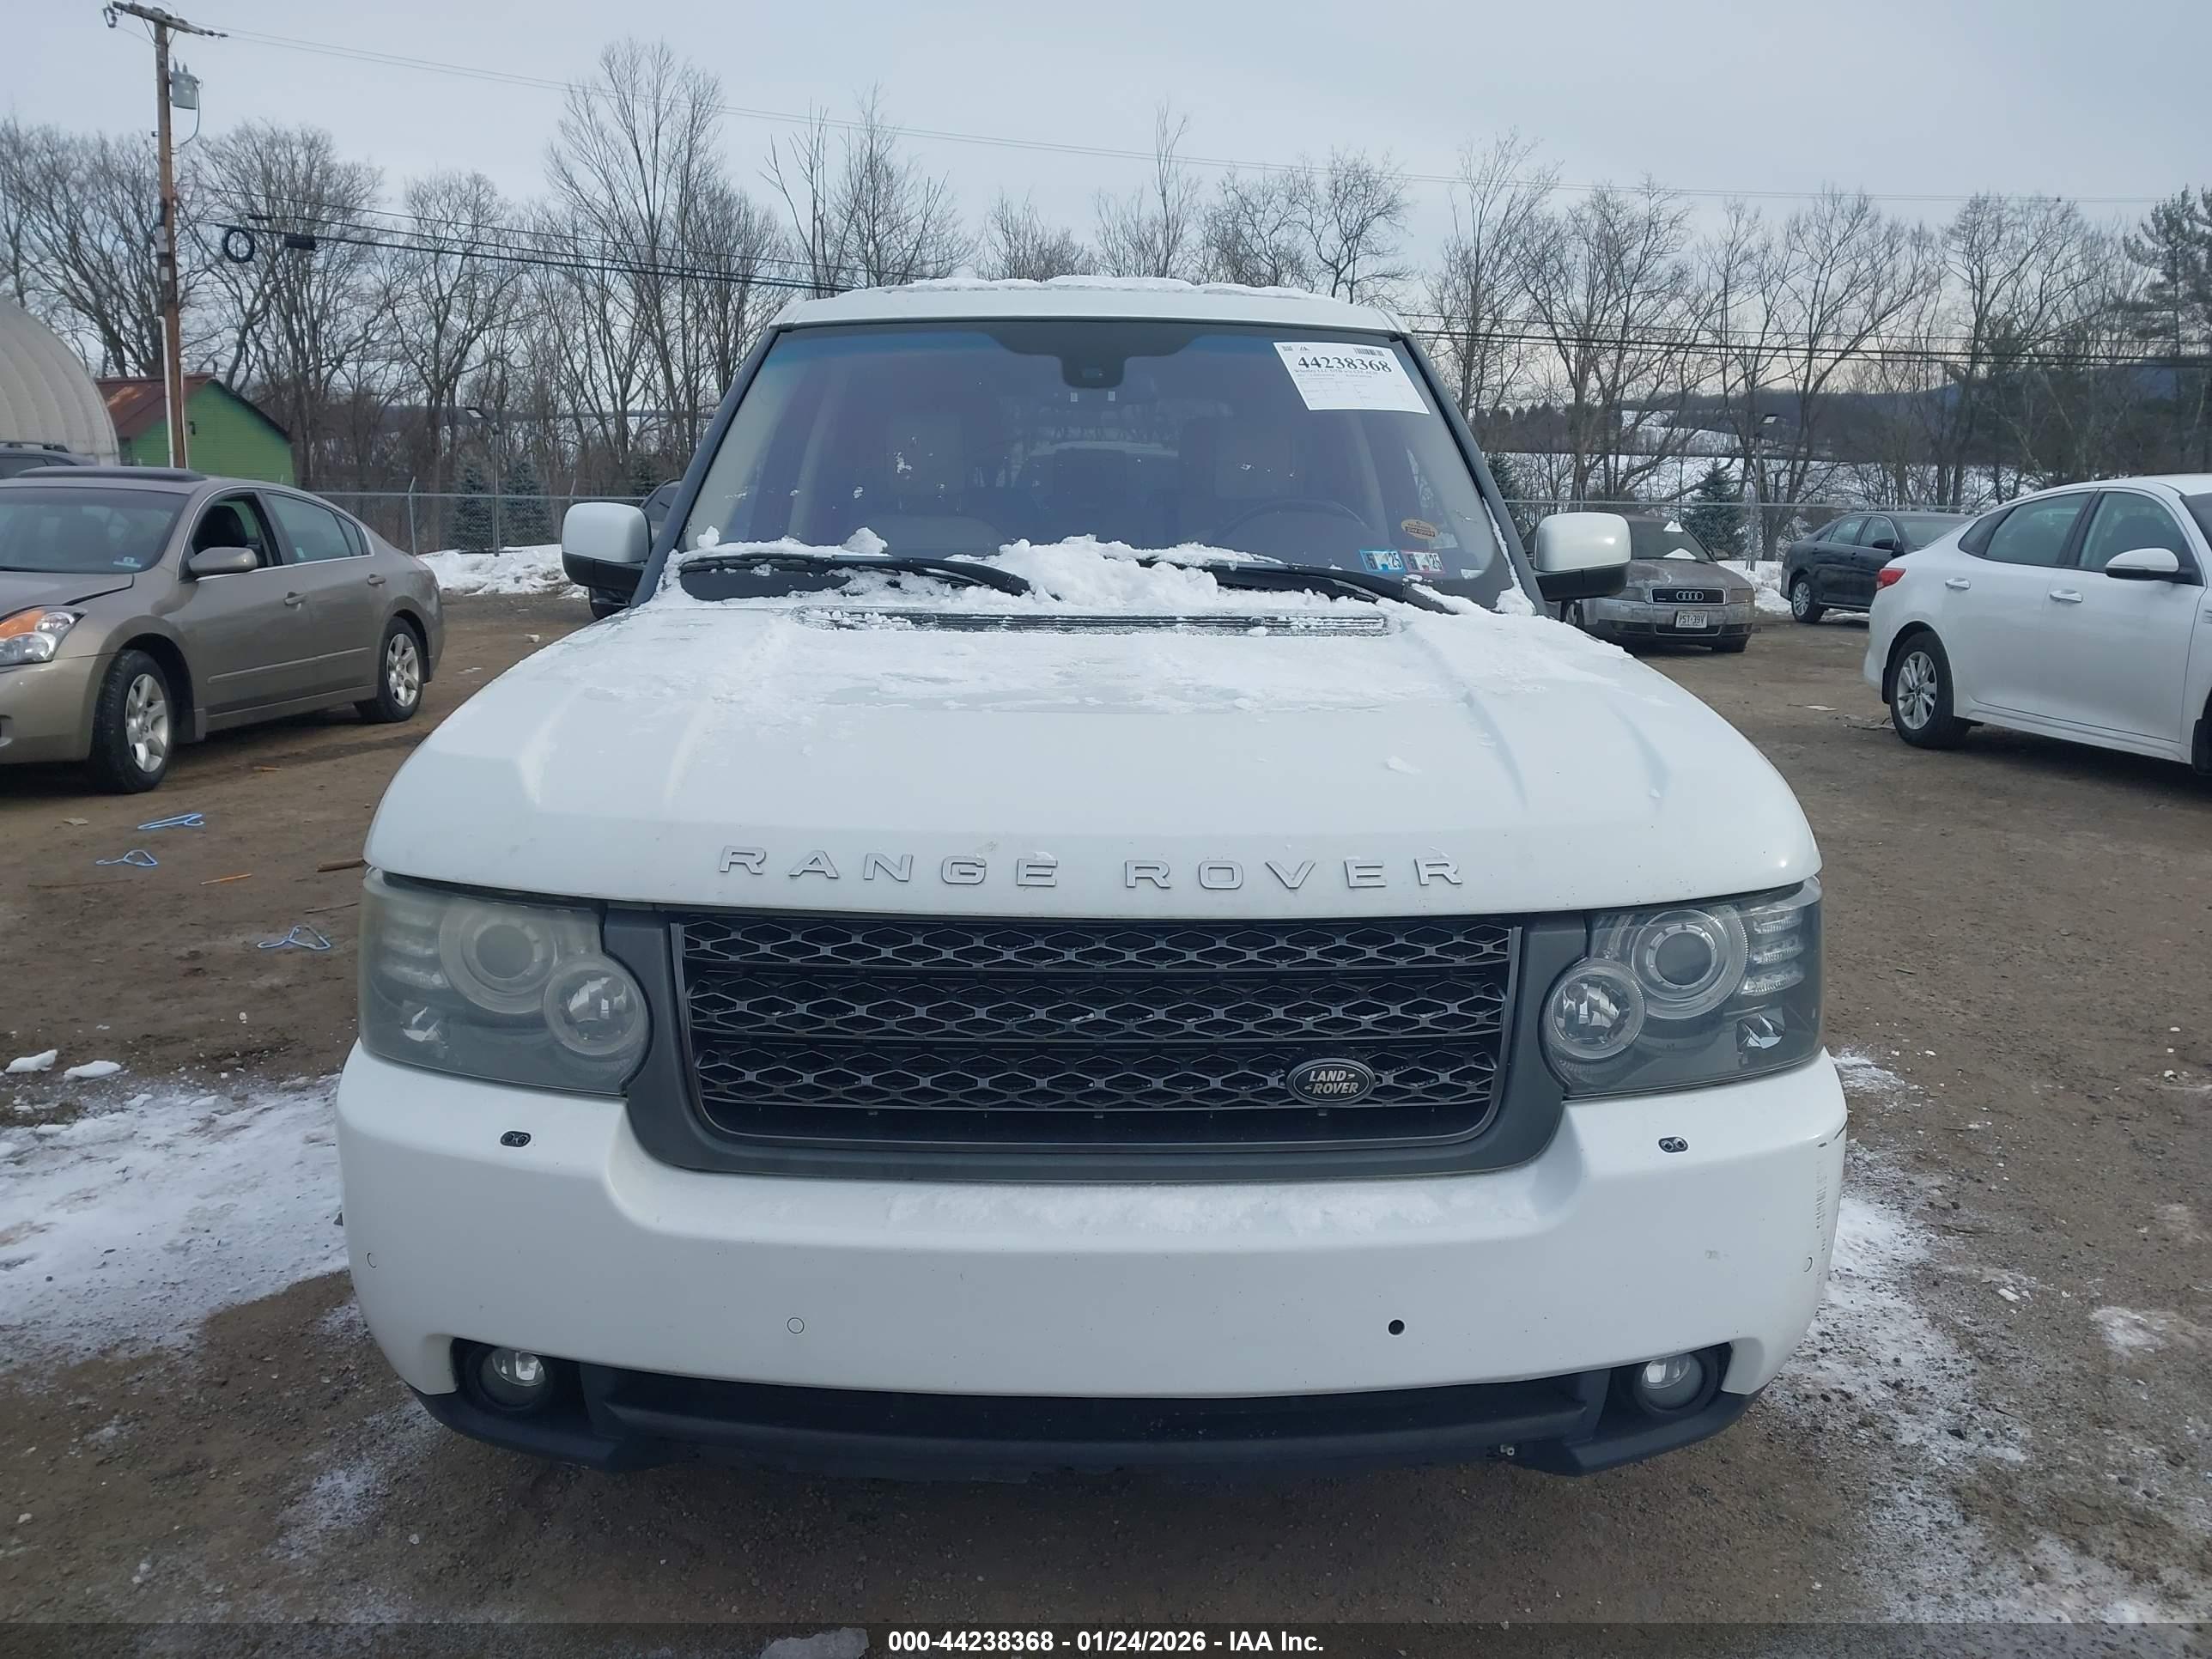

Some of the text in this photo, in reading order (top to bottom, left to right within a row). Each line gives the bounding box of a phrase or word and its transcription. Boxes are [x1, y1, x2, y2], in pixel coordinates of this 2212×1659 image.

[1297, 356, 1393, 373] 44238368
[1388, 552, 1402, 568] 25
[1429, 554, 1443, 570] 25
[719, 845, 1463, 889] RANGE ROVER
[1309, 1070, 1347, 1082] LAND
[1312, 1082, 1359, 1094] ROVER
